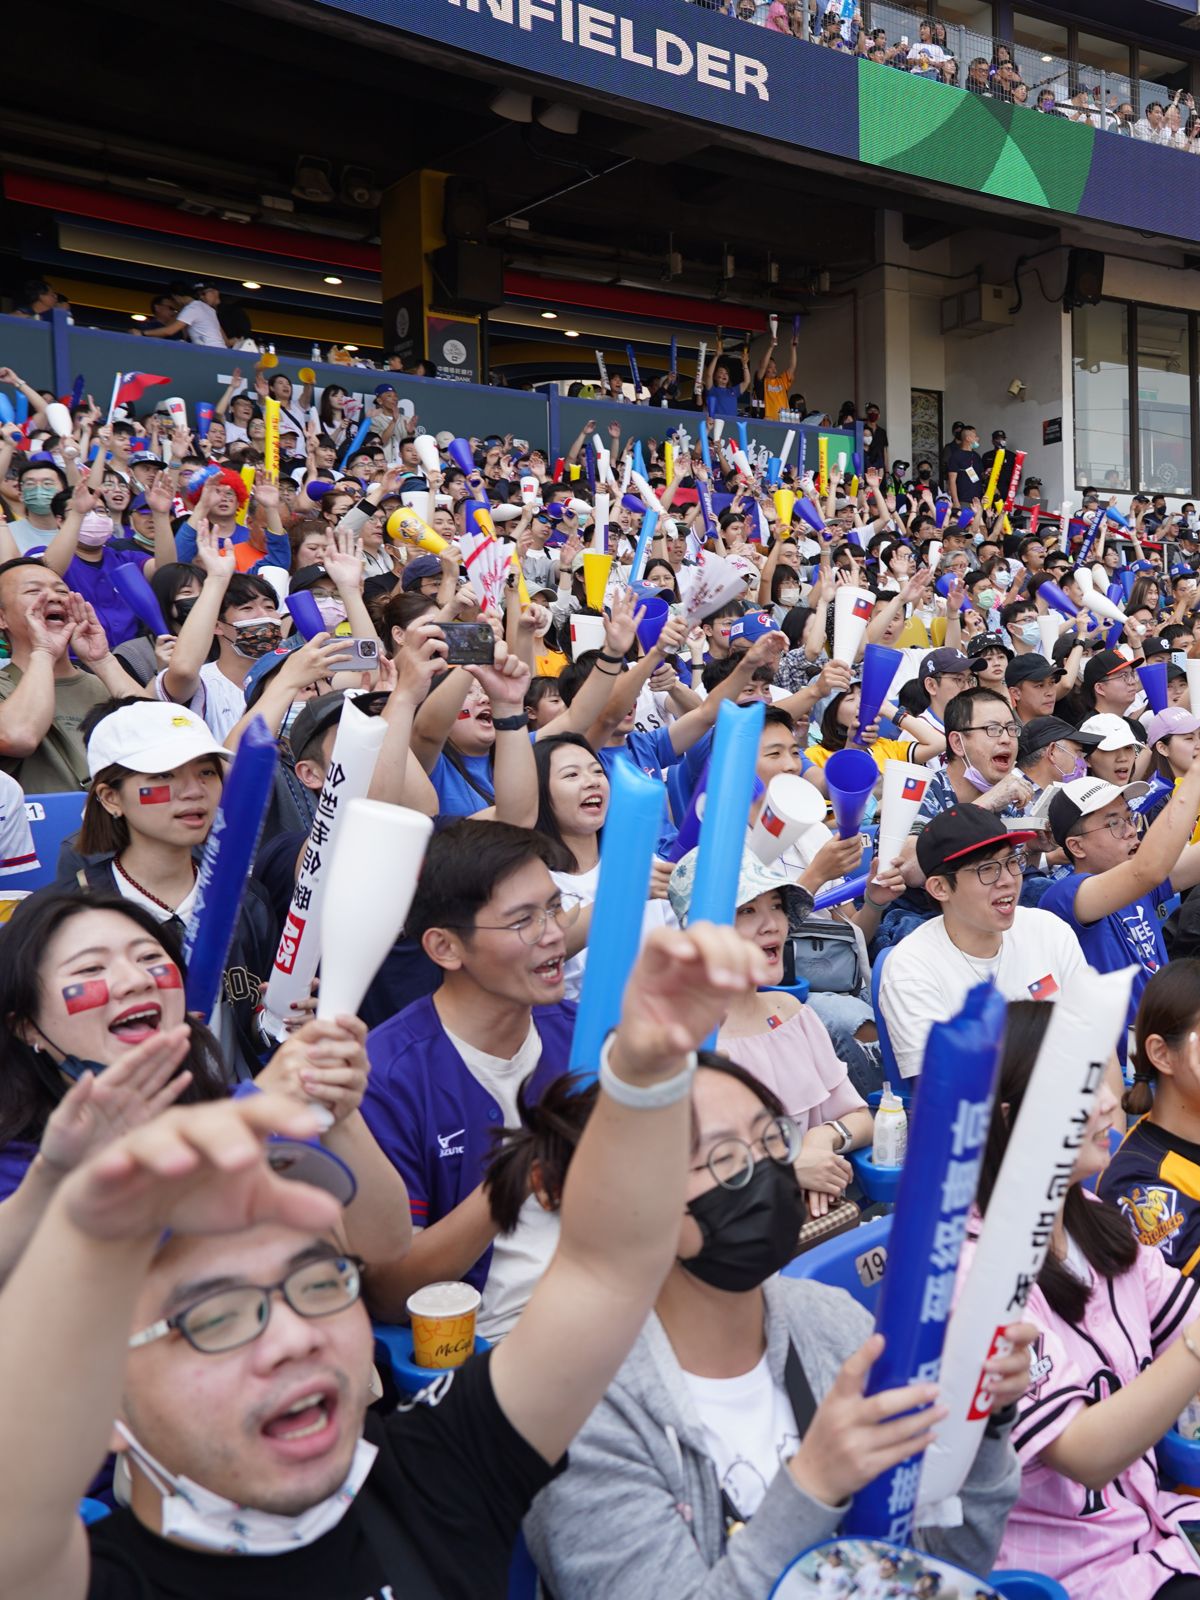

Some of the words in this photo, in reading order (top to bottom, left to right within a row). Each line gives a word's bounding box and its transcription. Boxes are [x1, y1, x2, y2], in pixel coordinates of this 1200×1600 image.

[448, 0, 769, 101] NFIELDER
[276, 922, 301, 970] A25
[862, 1253, 887, 1282] 19
